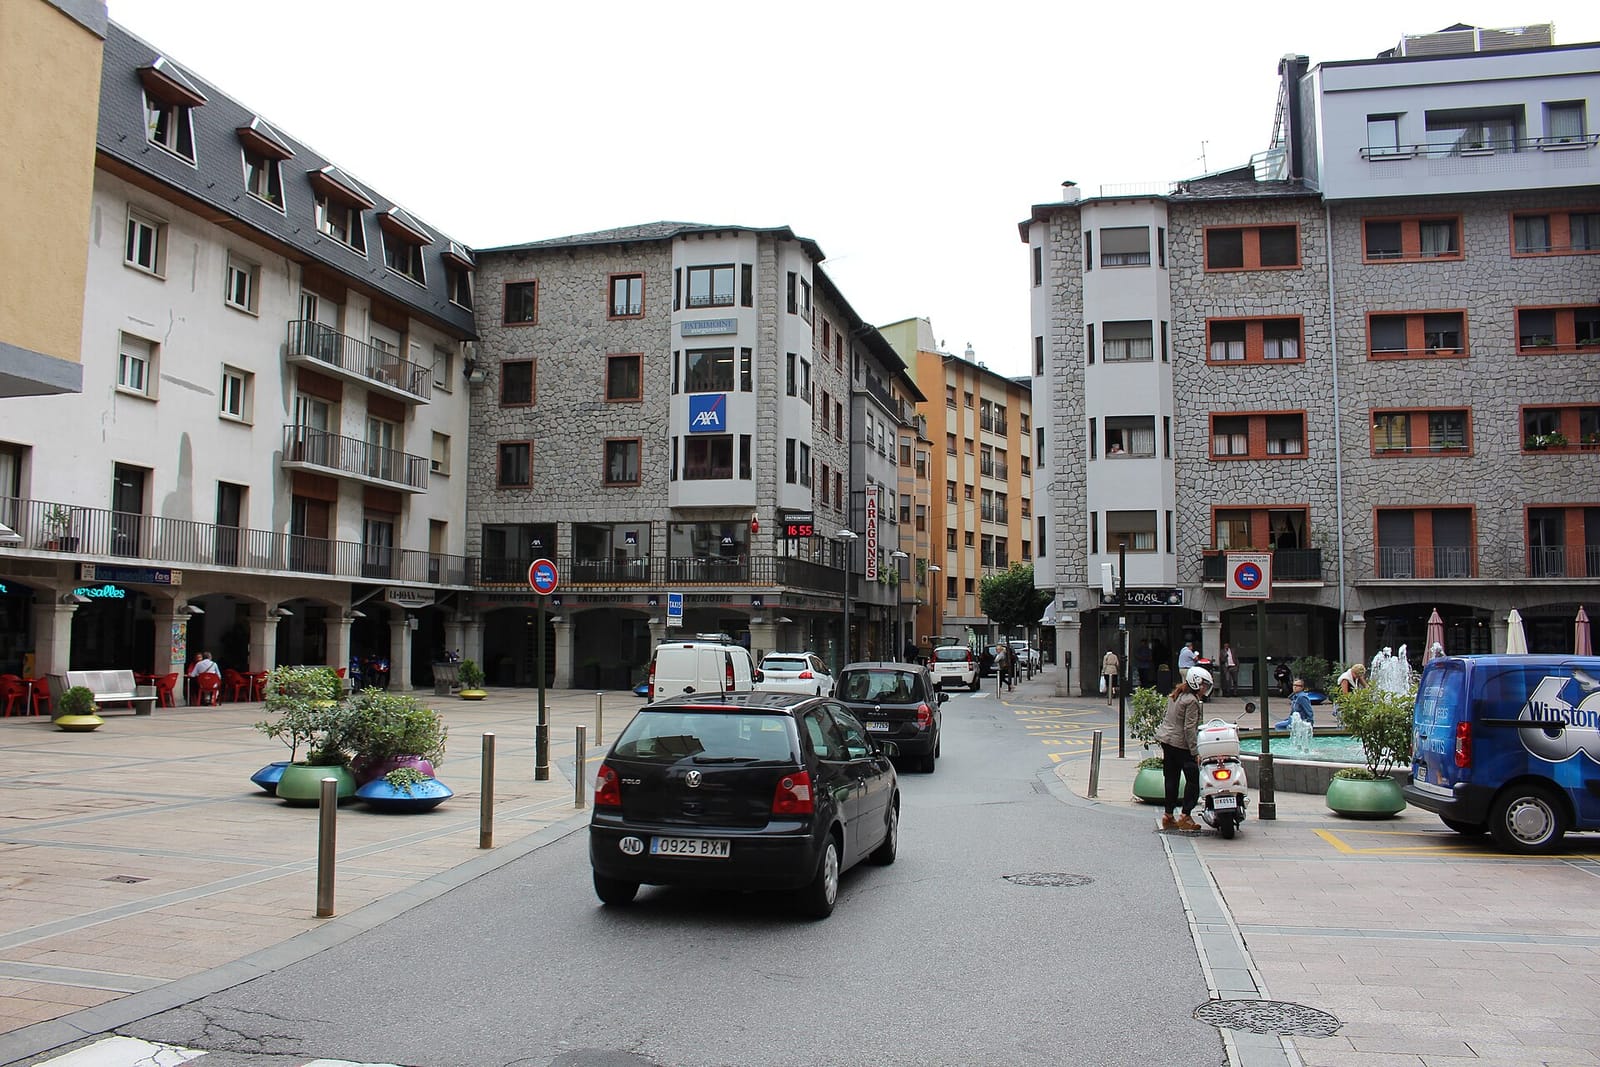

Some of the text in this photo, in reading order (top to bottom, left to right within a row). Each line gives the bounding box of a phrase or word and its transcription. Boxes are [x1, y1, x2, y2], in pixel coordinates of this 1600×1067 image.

[692, 411, 719, 425] AXA
[788, 525, 812, 536] 16 55
[74, 585, 125, 599] versalles
[1528, 700, 1598, 728] Winston
[623, 838, 640, 853] AND
[660, 839, 697, 854] 0925
